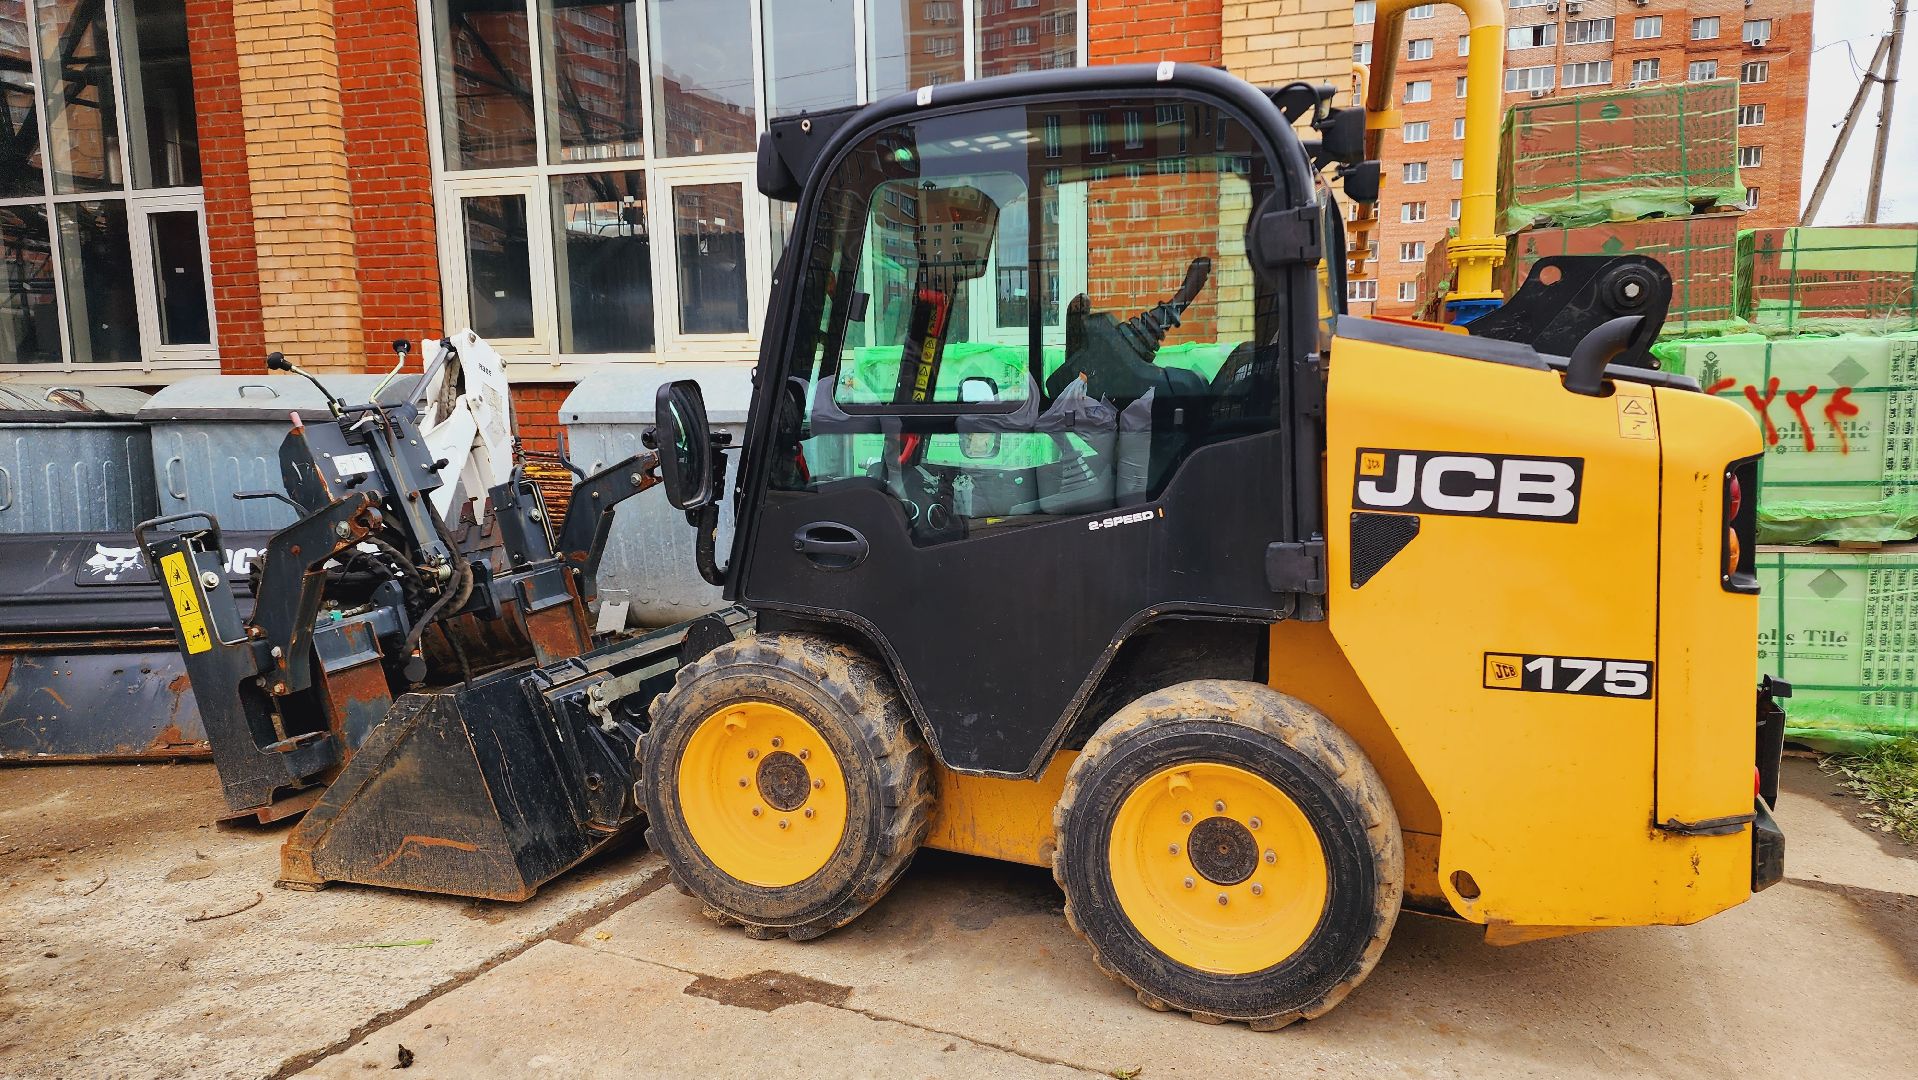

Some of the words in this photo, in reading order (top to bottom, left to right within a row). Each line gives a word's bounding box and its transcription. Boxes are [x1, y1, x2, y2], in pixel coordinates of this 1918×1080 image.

[1759, 272, 1828, 287] Perspolis
[1832, 271, 1860, 282] Tile
[1357, 454, 1576, 517] JCB
[1088, 510, 1155, 531] 2-SPEED
[1803, 629, 1849, 647] Tile
[1495, 663, 1516, 679] JCB
[1524, 657, 1648, 696] 175
